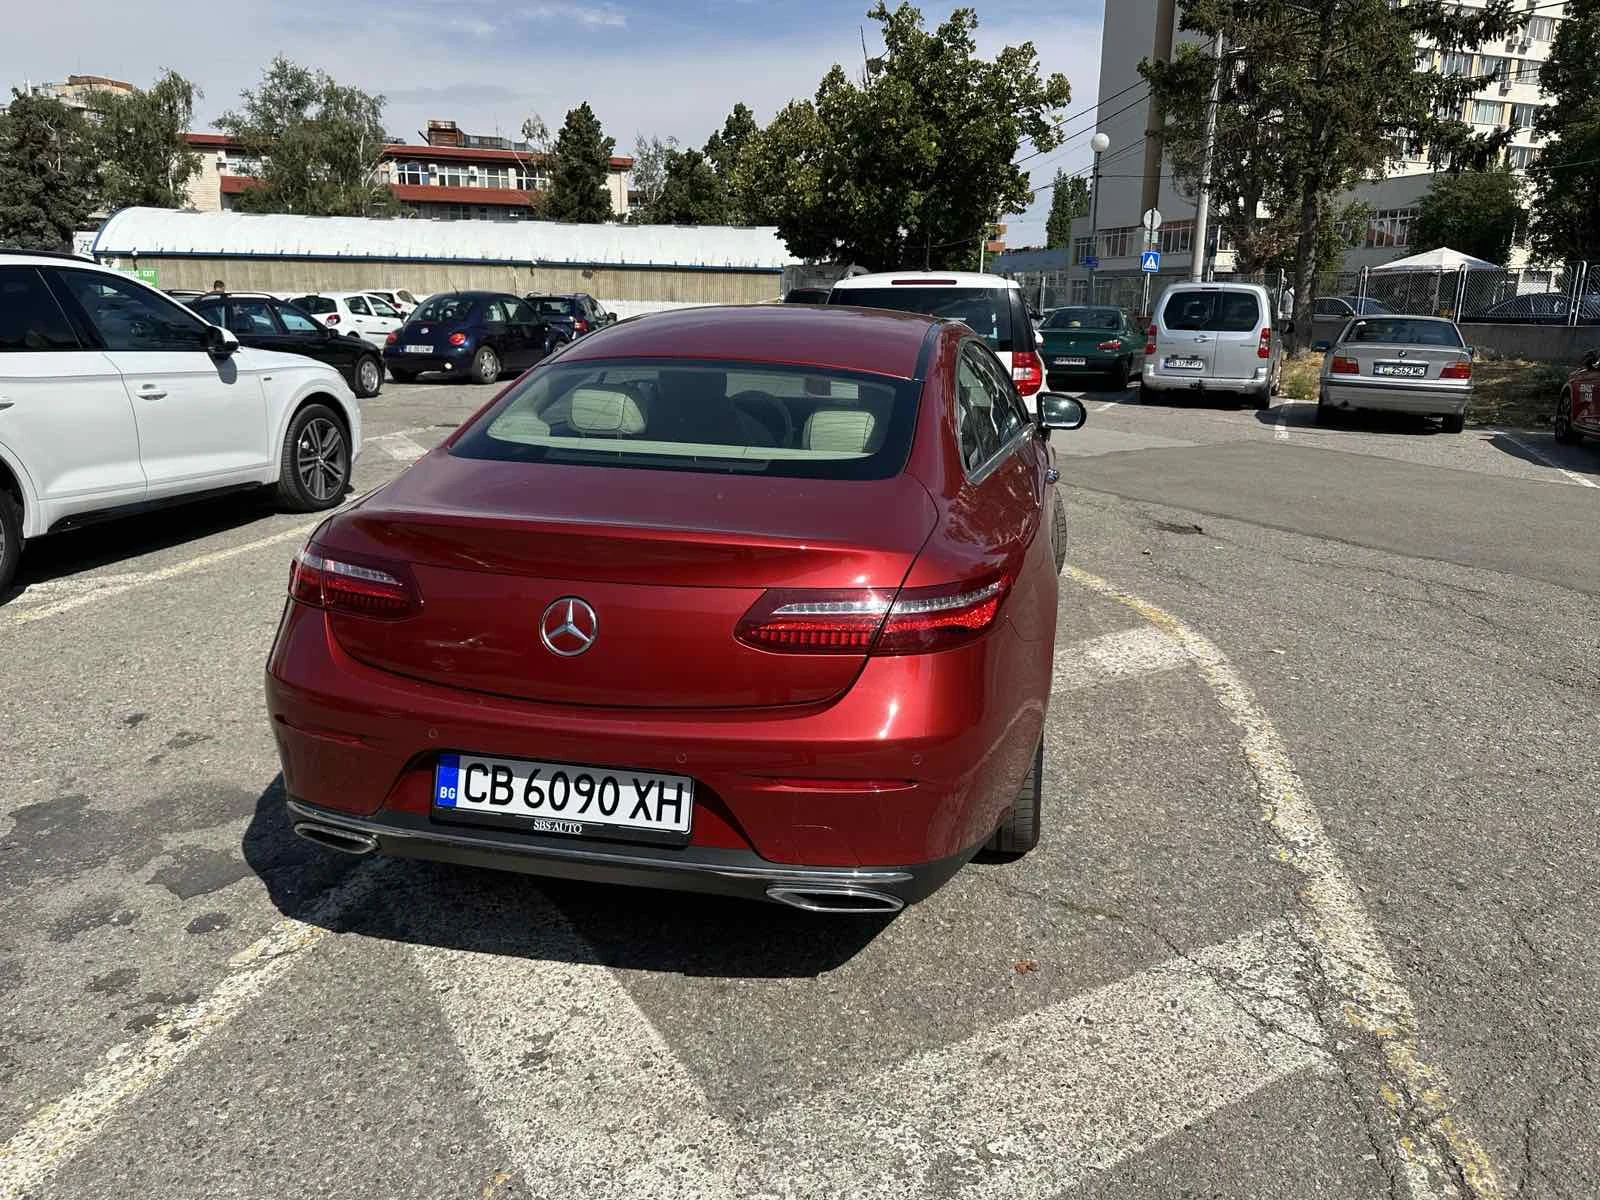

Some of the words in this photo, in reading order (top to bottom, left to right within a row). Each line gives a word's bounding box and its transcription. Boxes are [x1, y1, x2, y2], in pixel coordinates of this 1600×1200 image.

[439, 786, 456, 800] BG
[464, 763, 514, 806] CB
[523, 768, 620, 816] 6090
[629, 778, 684, 823] XH
